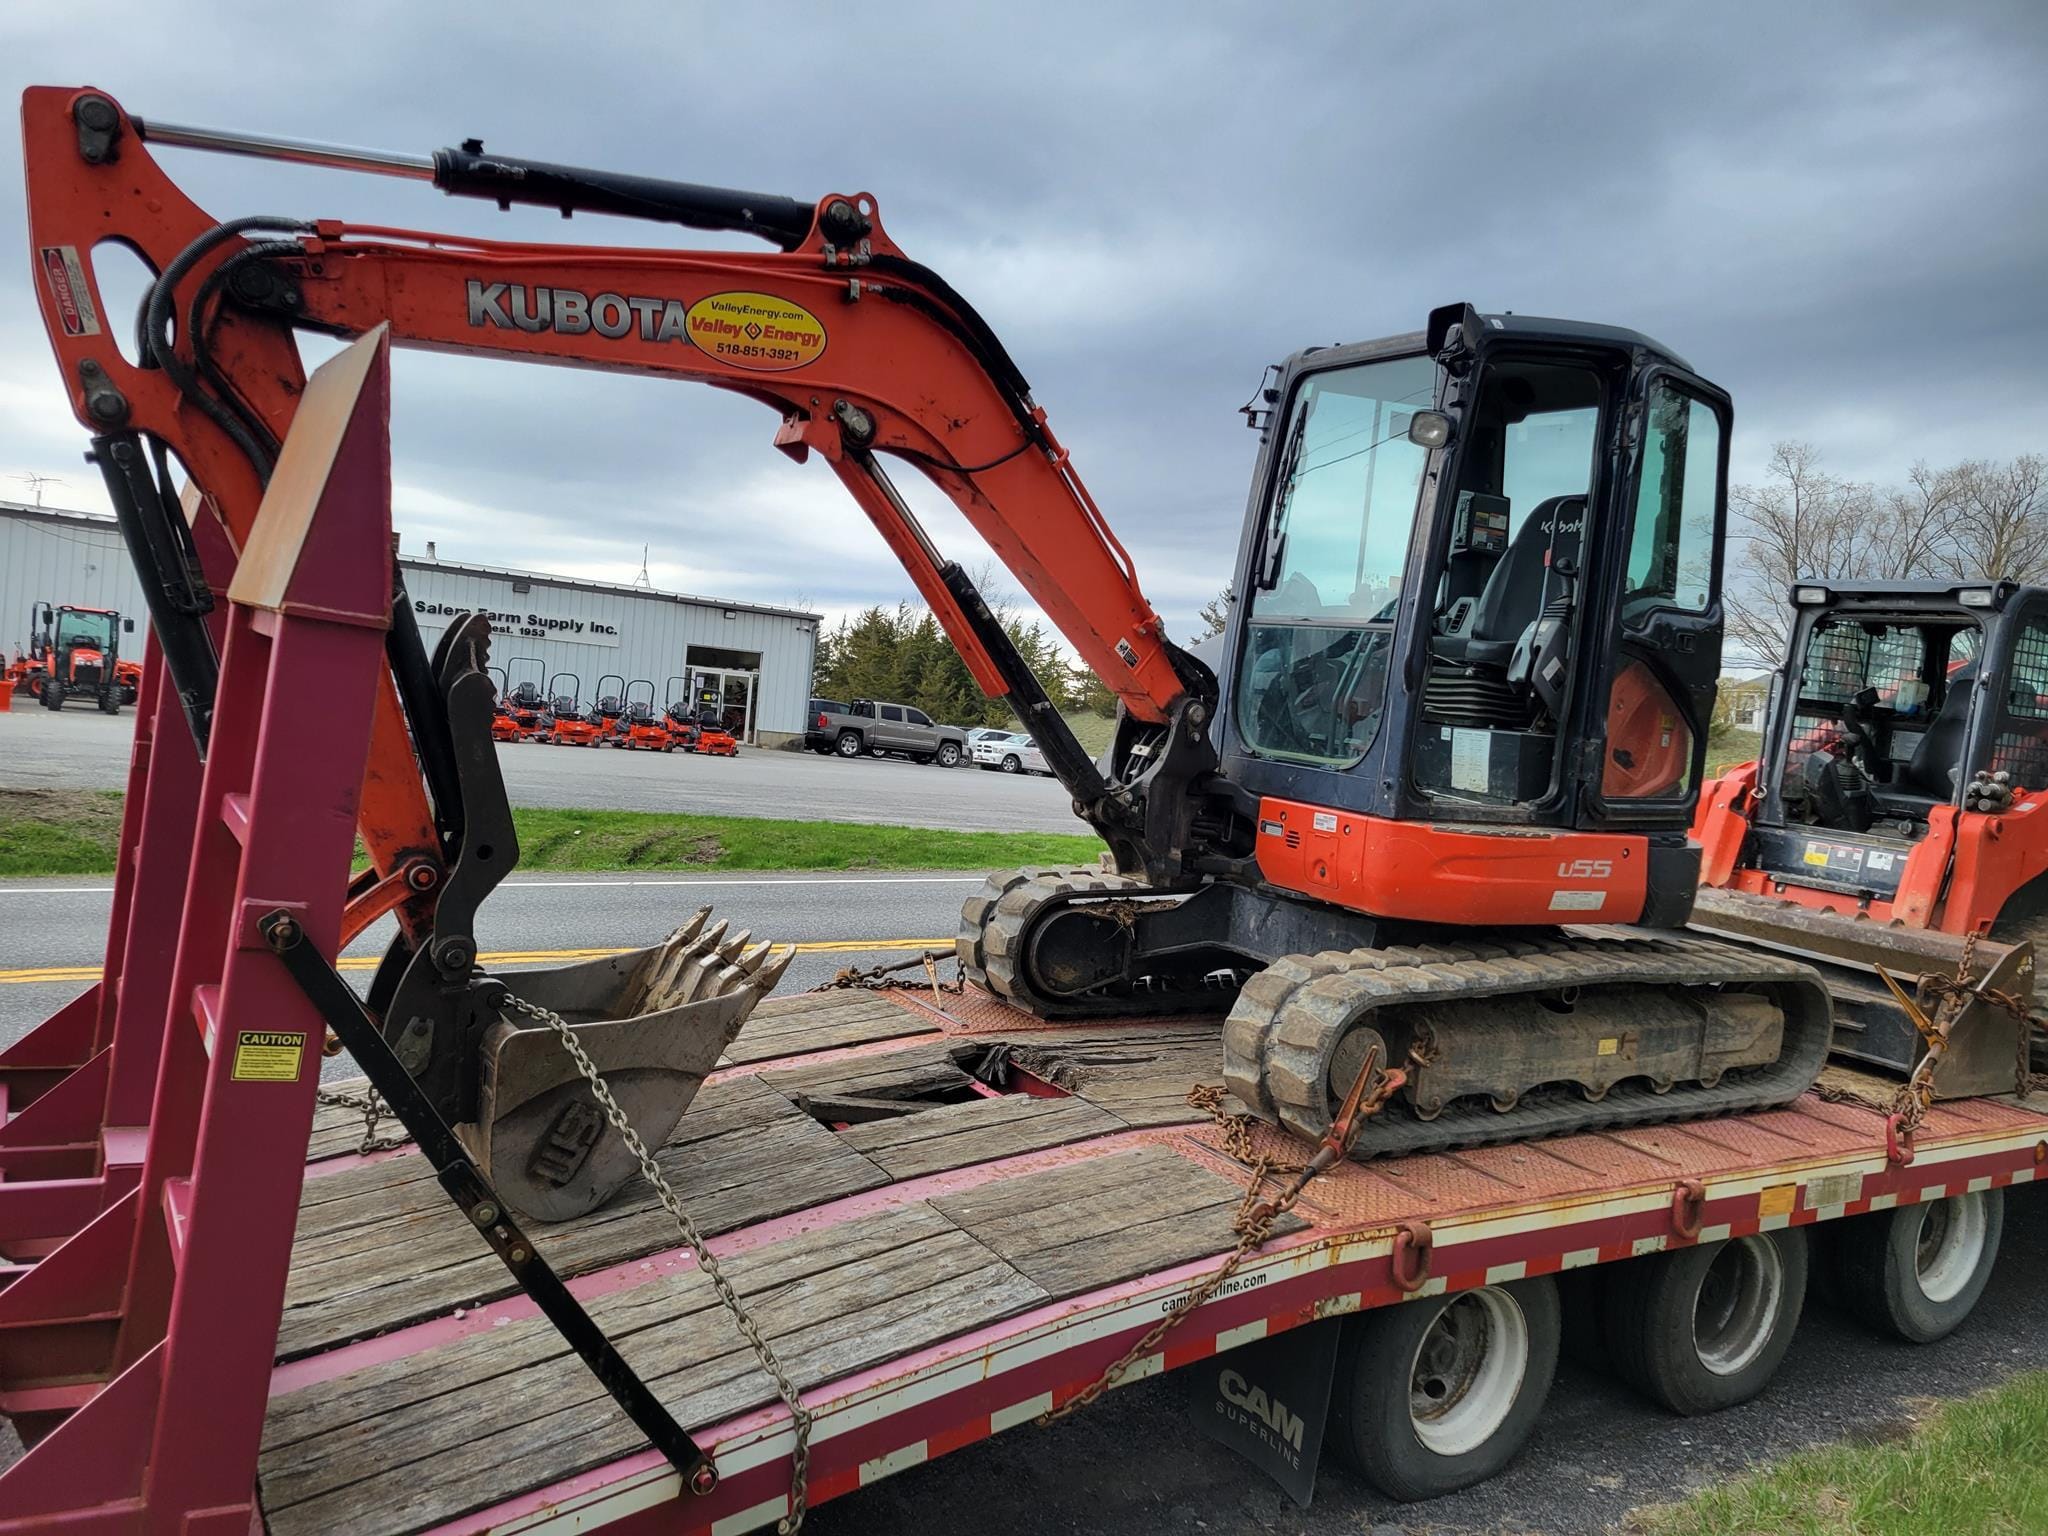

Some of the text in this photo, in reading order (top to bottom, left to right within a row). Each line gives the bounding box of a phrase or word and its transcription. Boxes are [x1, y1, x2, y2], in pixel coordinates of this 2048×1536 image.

[53, 268, 75, 315] DANGER
[466, 279, 689, 345] KUBOTA
[711, 301, 804, 320] ValleyEnergy.com
[691, 316, 821, 347] Valley Energy
[716, 342, 799, 361] 518-851-3921
[519, 627, 545, 637] 1953
[527, 614, 584, 633] Supply
[590, 621, 617, 635] Inc.
[241, 1033, 303, 1046] CAUTION
[1218, 1312, 1305, 1368] CAM
[1214, 1399, 1300, 1472] SUPERLINE
